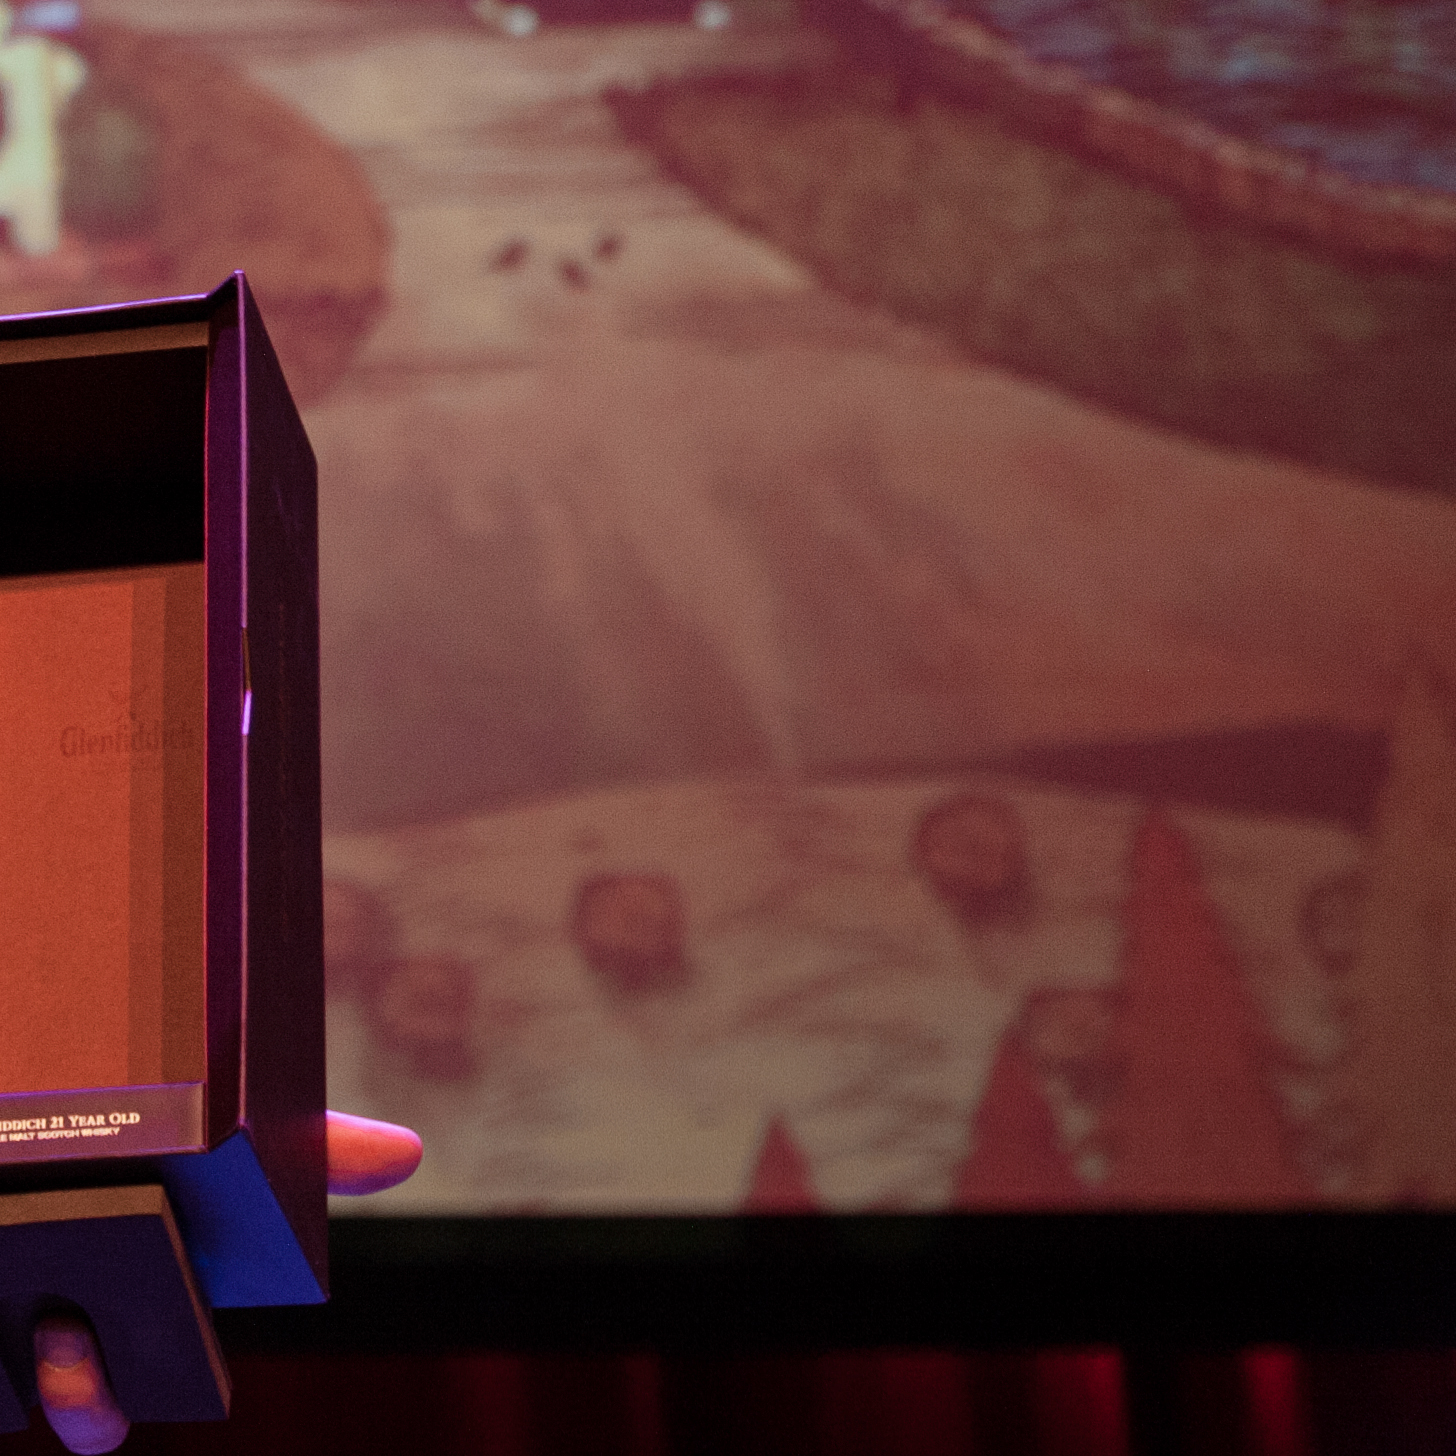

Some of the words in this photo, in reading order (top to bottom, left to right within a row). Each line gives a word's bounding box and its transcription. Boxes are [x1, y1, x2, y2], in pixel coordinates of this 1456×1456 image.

[59, 720, 195, 758] Glenfiddich
[50, 1116, 65, 1129] 21
[68, 1114, 106, 1128] YEAR
[109, 1112, 141, 1125] OLD
[37, 1129, 80, 1140] SCOTCH
[81, 1127, 121, 1137] WHISKY
